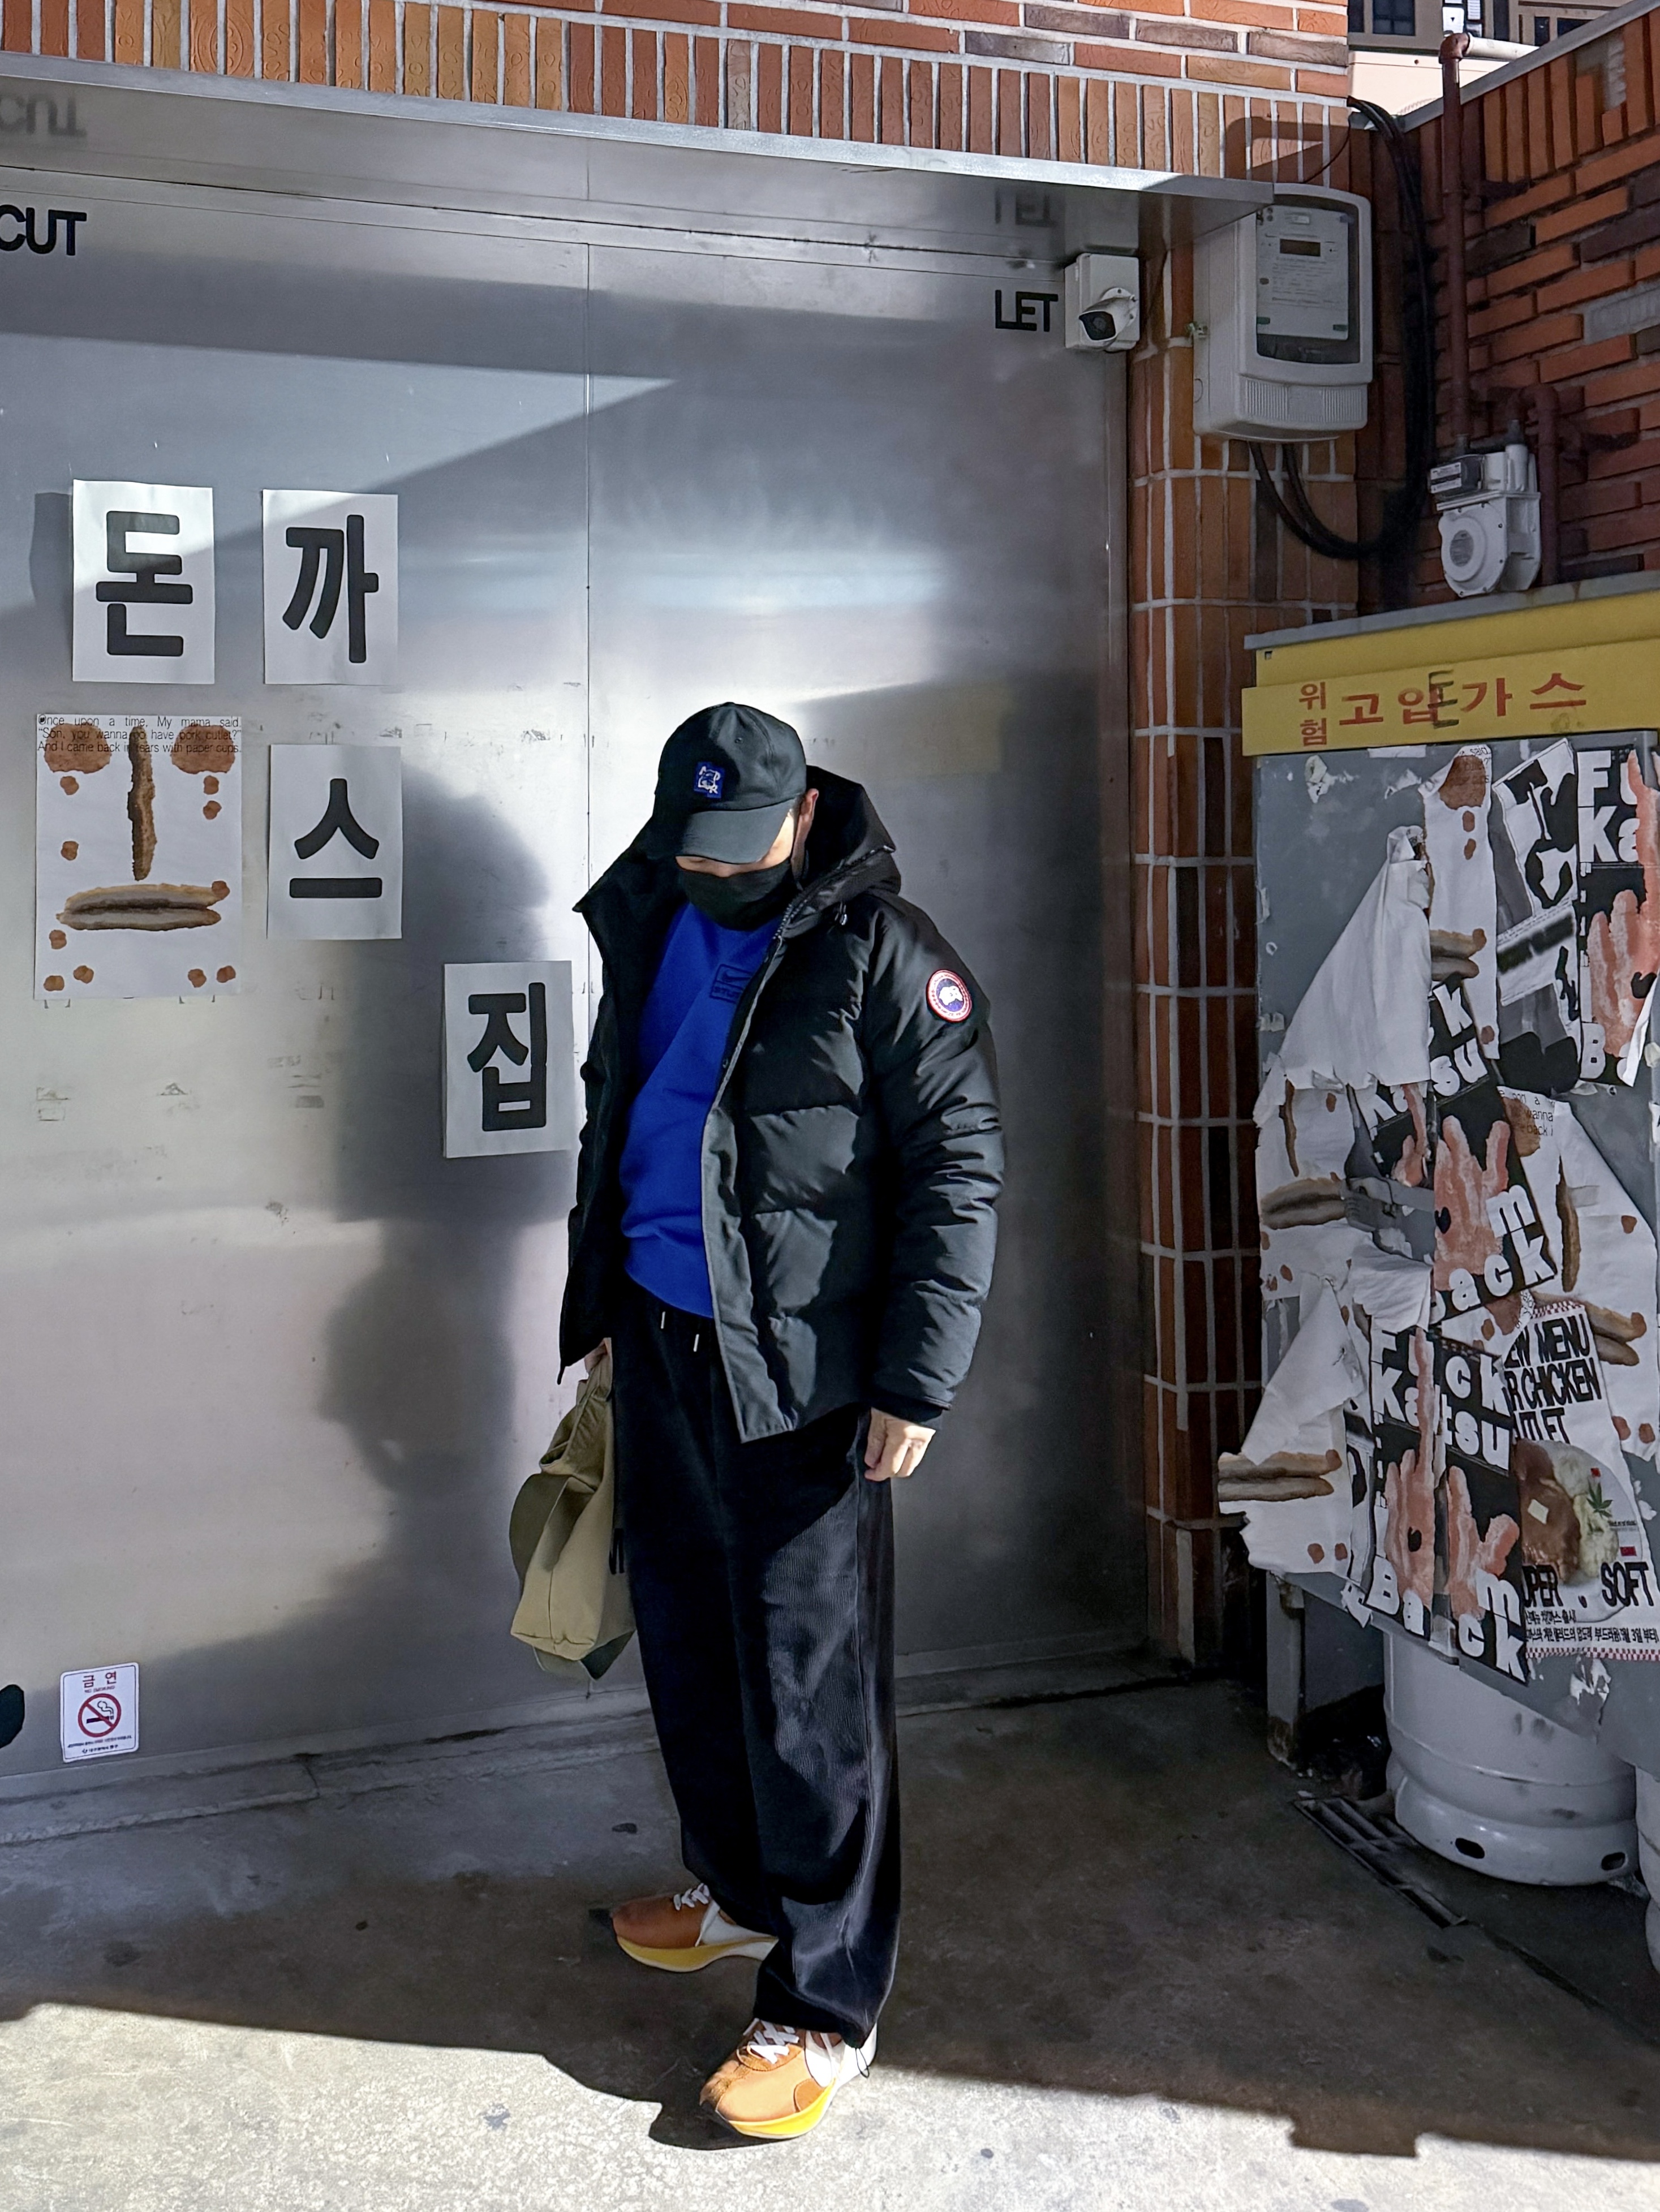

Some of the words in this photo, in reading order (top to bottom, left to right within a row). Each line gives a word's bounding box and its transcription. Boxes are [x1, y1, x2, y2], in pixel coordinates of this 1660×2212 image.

[0, 204, 87, 256] CUT
[995, 290, 1058, 332] LET
[96, 510, 193, 657] 돈
[282, 514, 379, 664] 까
[38, 715, 64, 725] Once
[74, 717, 99, 727] upon
[109, 717, 115, 726] a
[157, 716, 171, 729] My
[181, 718, 210, 727] mama
[72, 729, 89, 741] you
[96, 730, 127, 739] wanna
[151, 729, 174, 739] have
[179, 730, 200, 742] pork
[38, 741, 57, 752] And
[67, 744, 93, 752] came
[97, 742, 121, 752] back
[162, 742, 183, 752] with
[186, 743, 213, 755] paper
[290, 778, 382, 898] 스
[467, 982, 547, 1132] 집
[1534, 1314, 1590, 1363] MENU
[1521, 1357, 1602, 1409] CHICKEN
[1601, 1561, 1654, 1607] SOFT
